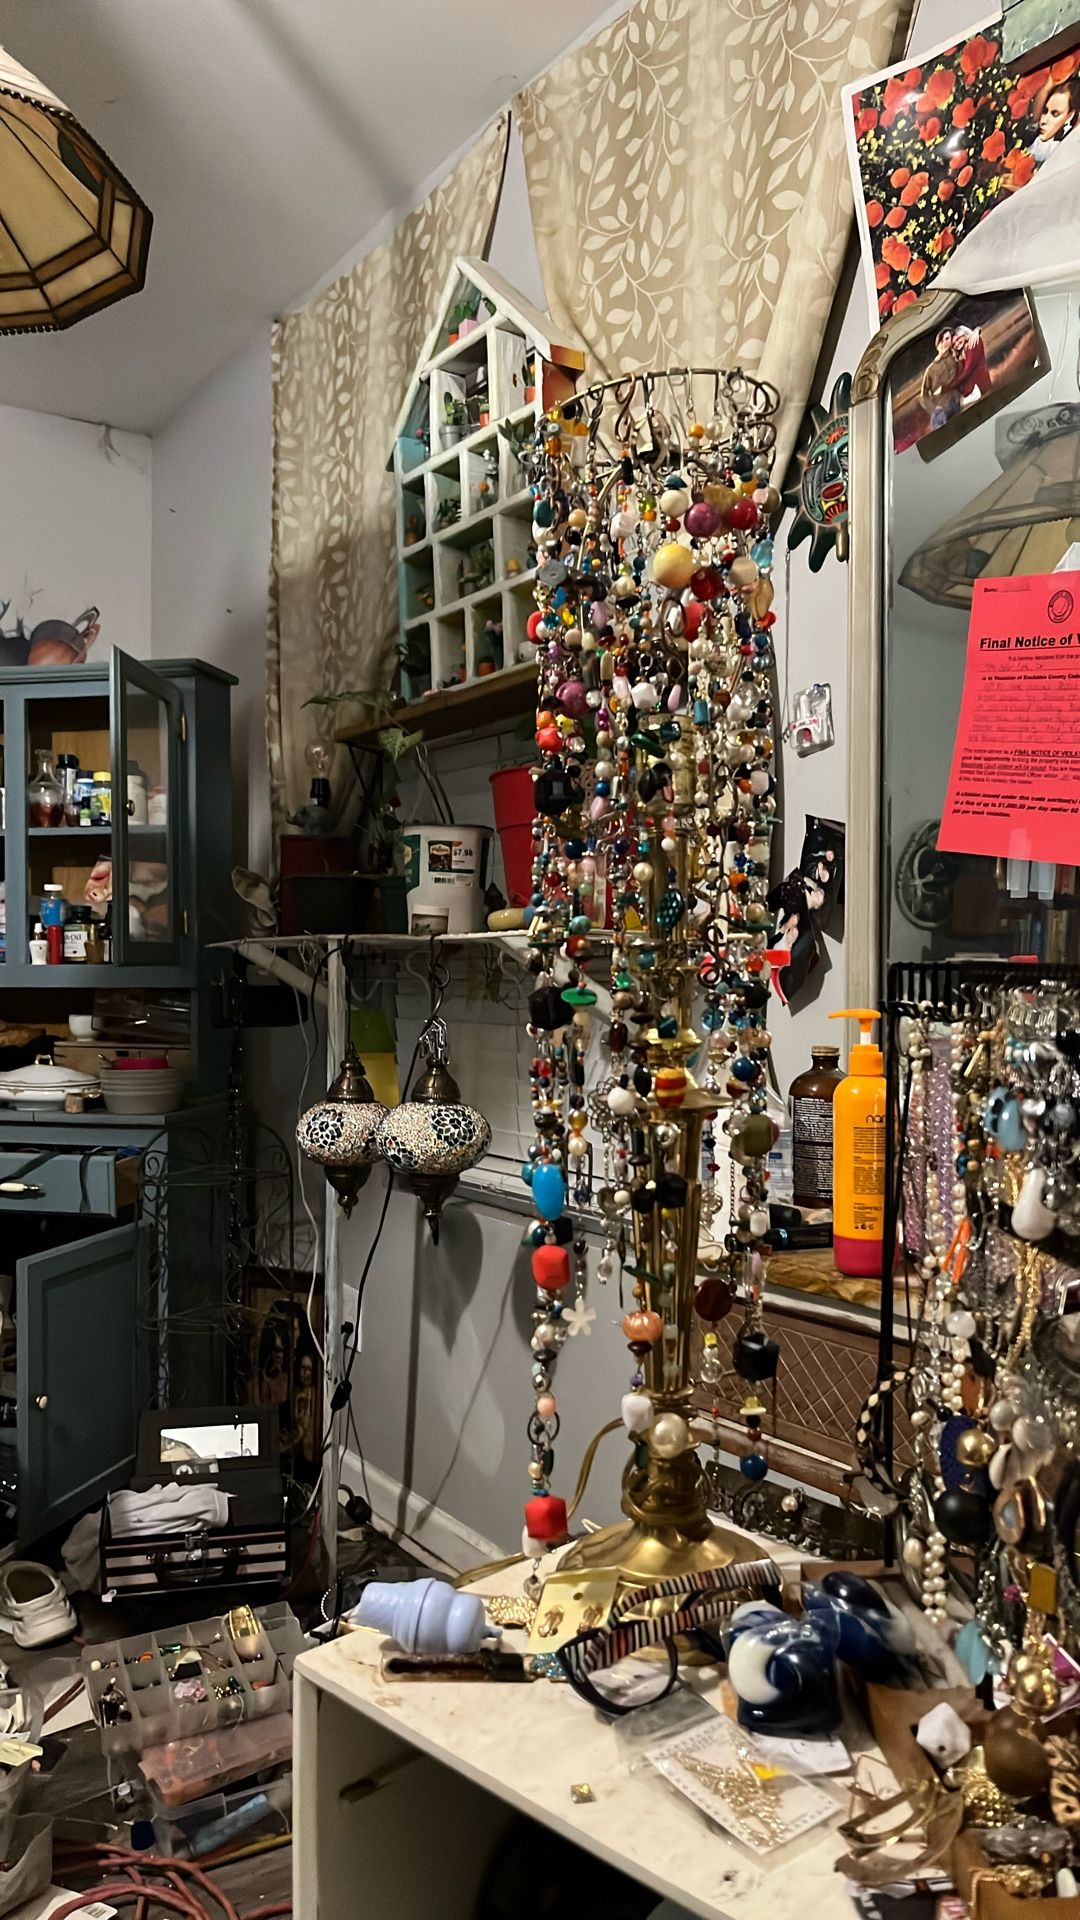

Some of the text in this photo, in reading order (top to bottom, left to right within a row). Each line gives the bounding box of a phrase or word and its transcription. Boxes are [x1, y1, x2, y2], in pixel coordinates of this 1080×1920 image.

[980, 637, 1011, 648] Final
[1015, 635, 1056, 648] Notice
[1060, 633, 1073, 645] of
